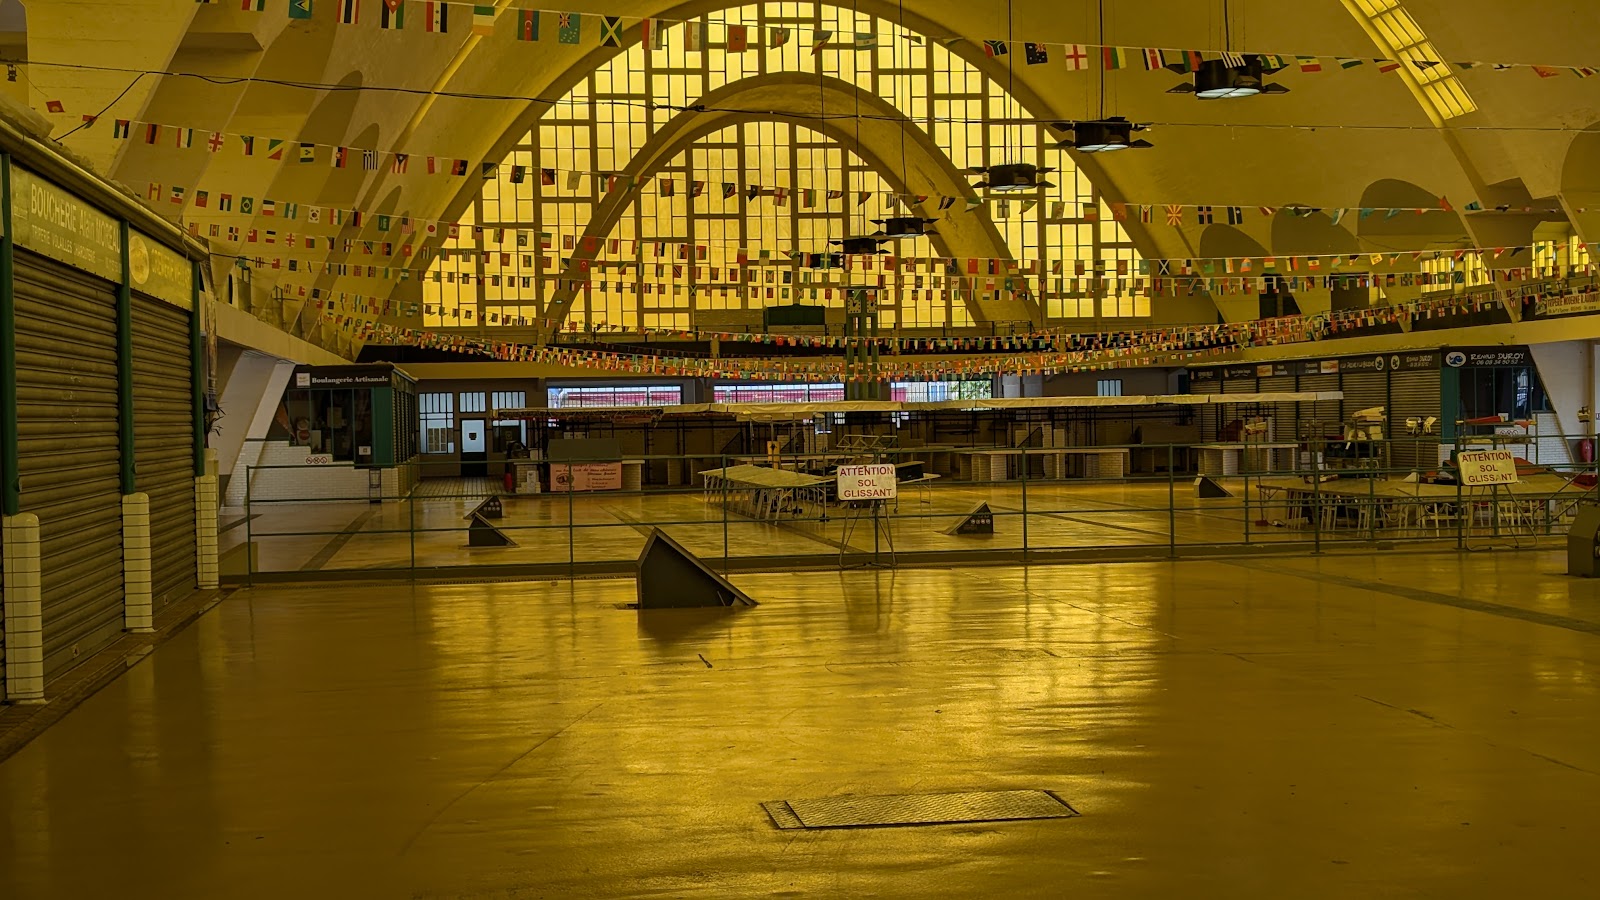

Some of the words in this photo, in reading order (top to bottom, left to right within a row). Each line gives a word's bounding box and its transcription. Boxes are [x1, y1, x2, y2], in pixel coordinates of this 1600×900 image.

[31, 183, 77, 233] BOUCHERIE
[79, 209, 95, 241] Alain
[95, 217, 121, 254] MOREAU
[52, 233, 73, 254] VOLAILLES
[1497, 352, 1524, 360] DUROY
[312, 376, 353, 384] Boulangerie
[1462, 452, 1512, 462] ATTENTION
[839, 466, 893, 476] ATTENTION
[1479, 464, 1498, 472] SOL
[1468, 473, 1512, 483] GLISSANT
[857, 479, 877, 487] SOL
[844, 489, 892, 498] GLISSANT
